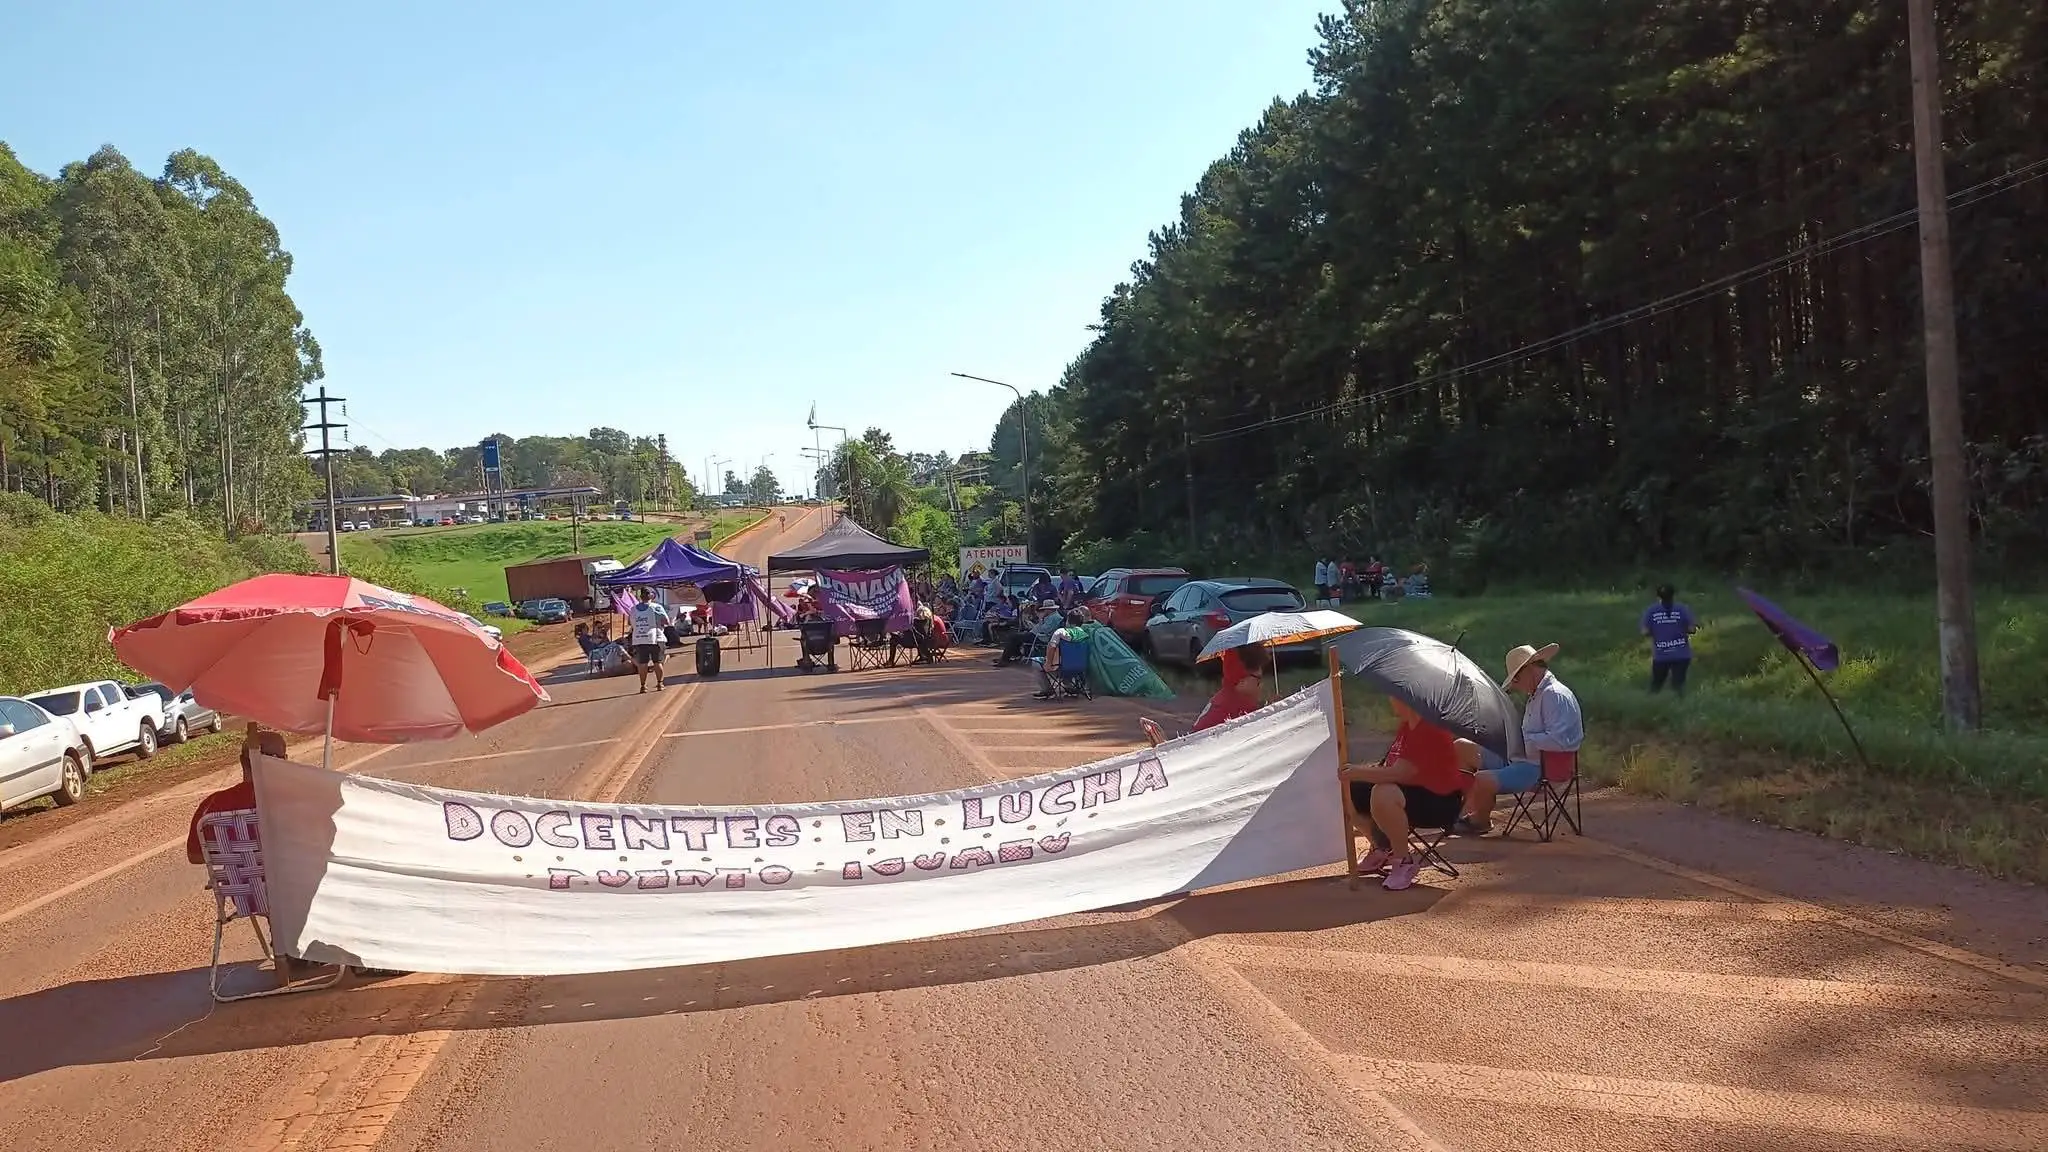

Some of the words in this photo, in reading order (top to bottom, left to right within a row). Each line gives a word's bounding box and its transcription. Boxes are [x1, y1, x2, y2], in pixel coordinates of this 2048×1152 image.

[966, 548, 1022, 559] ATENCION
[443, 801, 801, 851] DOCENTES
[841, 809, 925, 843] EN
[962, 756, 1169, 830] LUCHA
